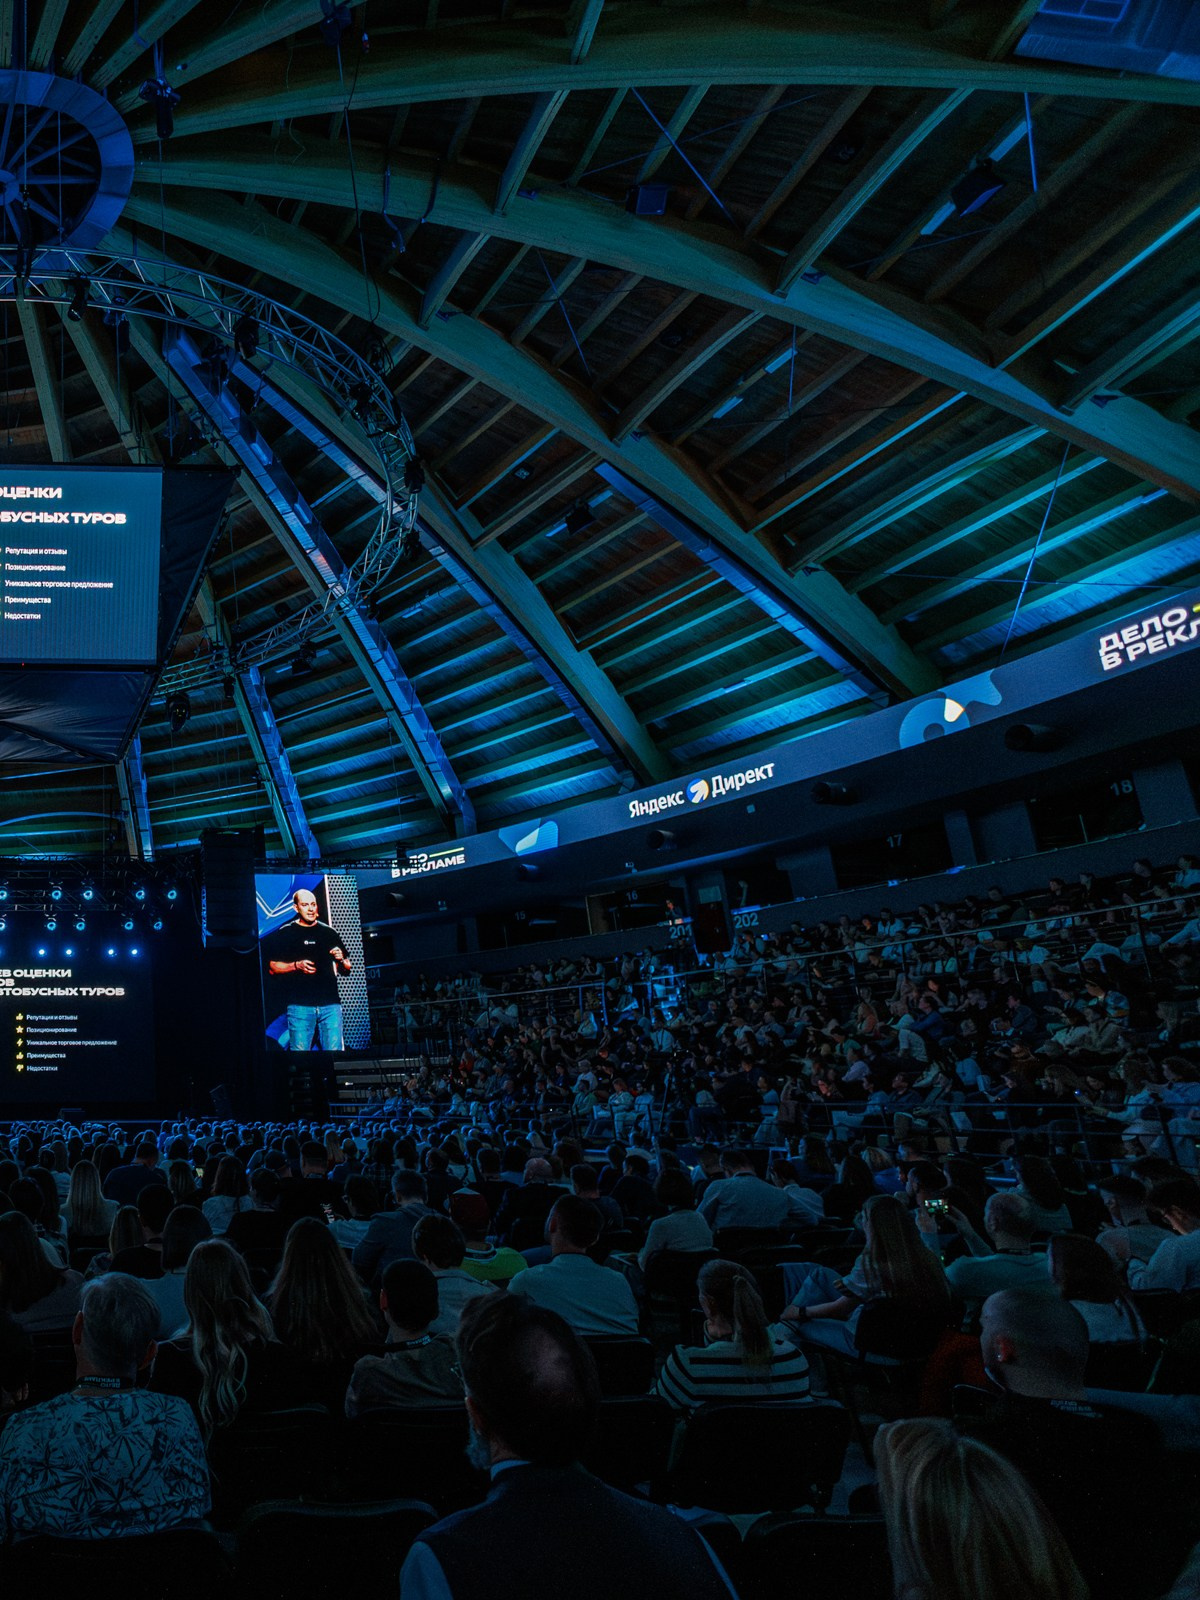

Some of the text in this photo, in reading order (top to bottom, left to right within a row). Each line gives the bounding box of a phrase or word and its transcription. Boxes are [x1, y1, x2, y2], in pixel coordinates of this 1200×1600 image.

[70, 512, 127, 524] ТУРОВ
[5, 547, 38, 555] Репутация
[5, 563, 66, 572] Позиционирование
[5, 580, 41, 588] Уникальное
[42, 581, 71, 589] торговое
[4, 596, 51, 604] Преимущества
[4, 612, 41, 620] Недостатки
[1099, 607, 1188, 657] ДЕЛО
[1101, 652, 1123, 671] В
[628, 762, 775, 818] Яндекс Директ
[1111, 779, 1134, 797] 18
[885, 833, 904, 849] 17
[733, 912, 760, 929] 202
[13, 969, 72, 979] ОЦЕНКИ
[79, 987, 125, 996] ТУРОВ
